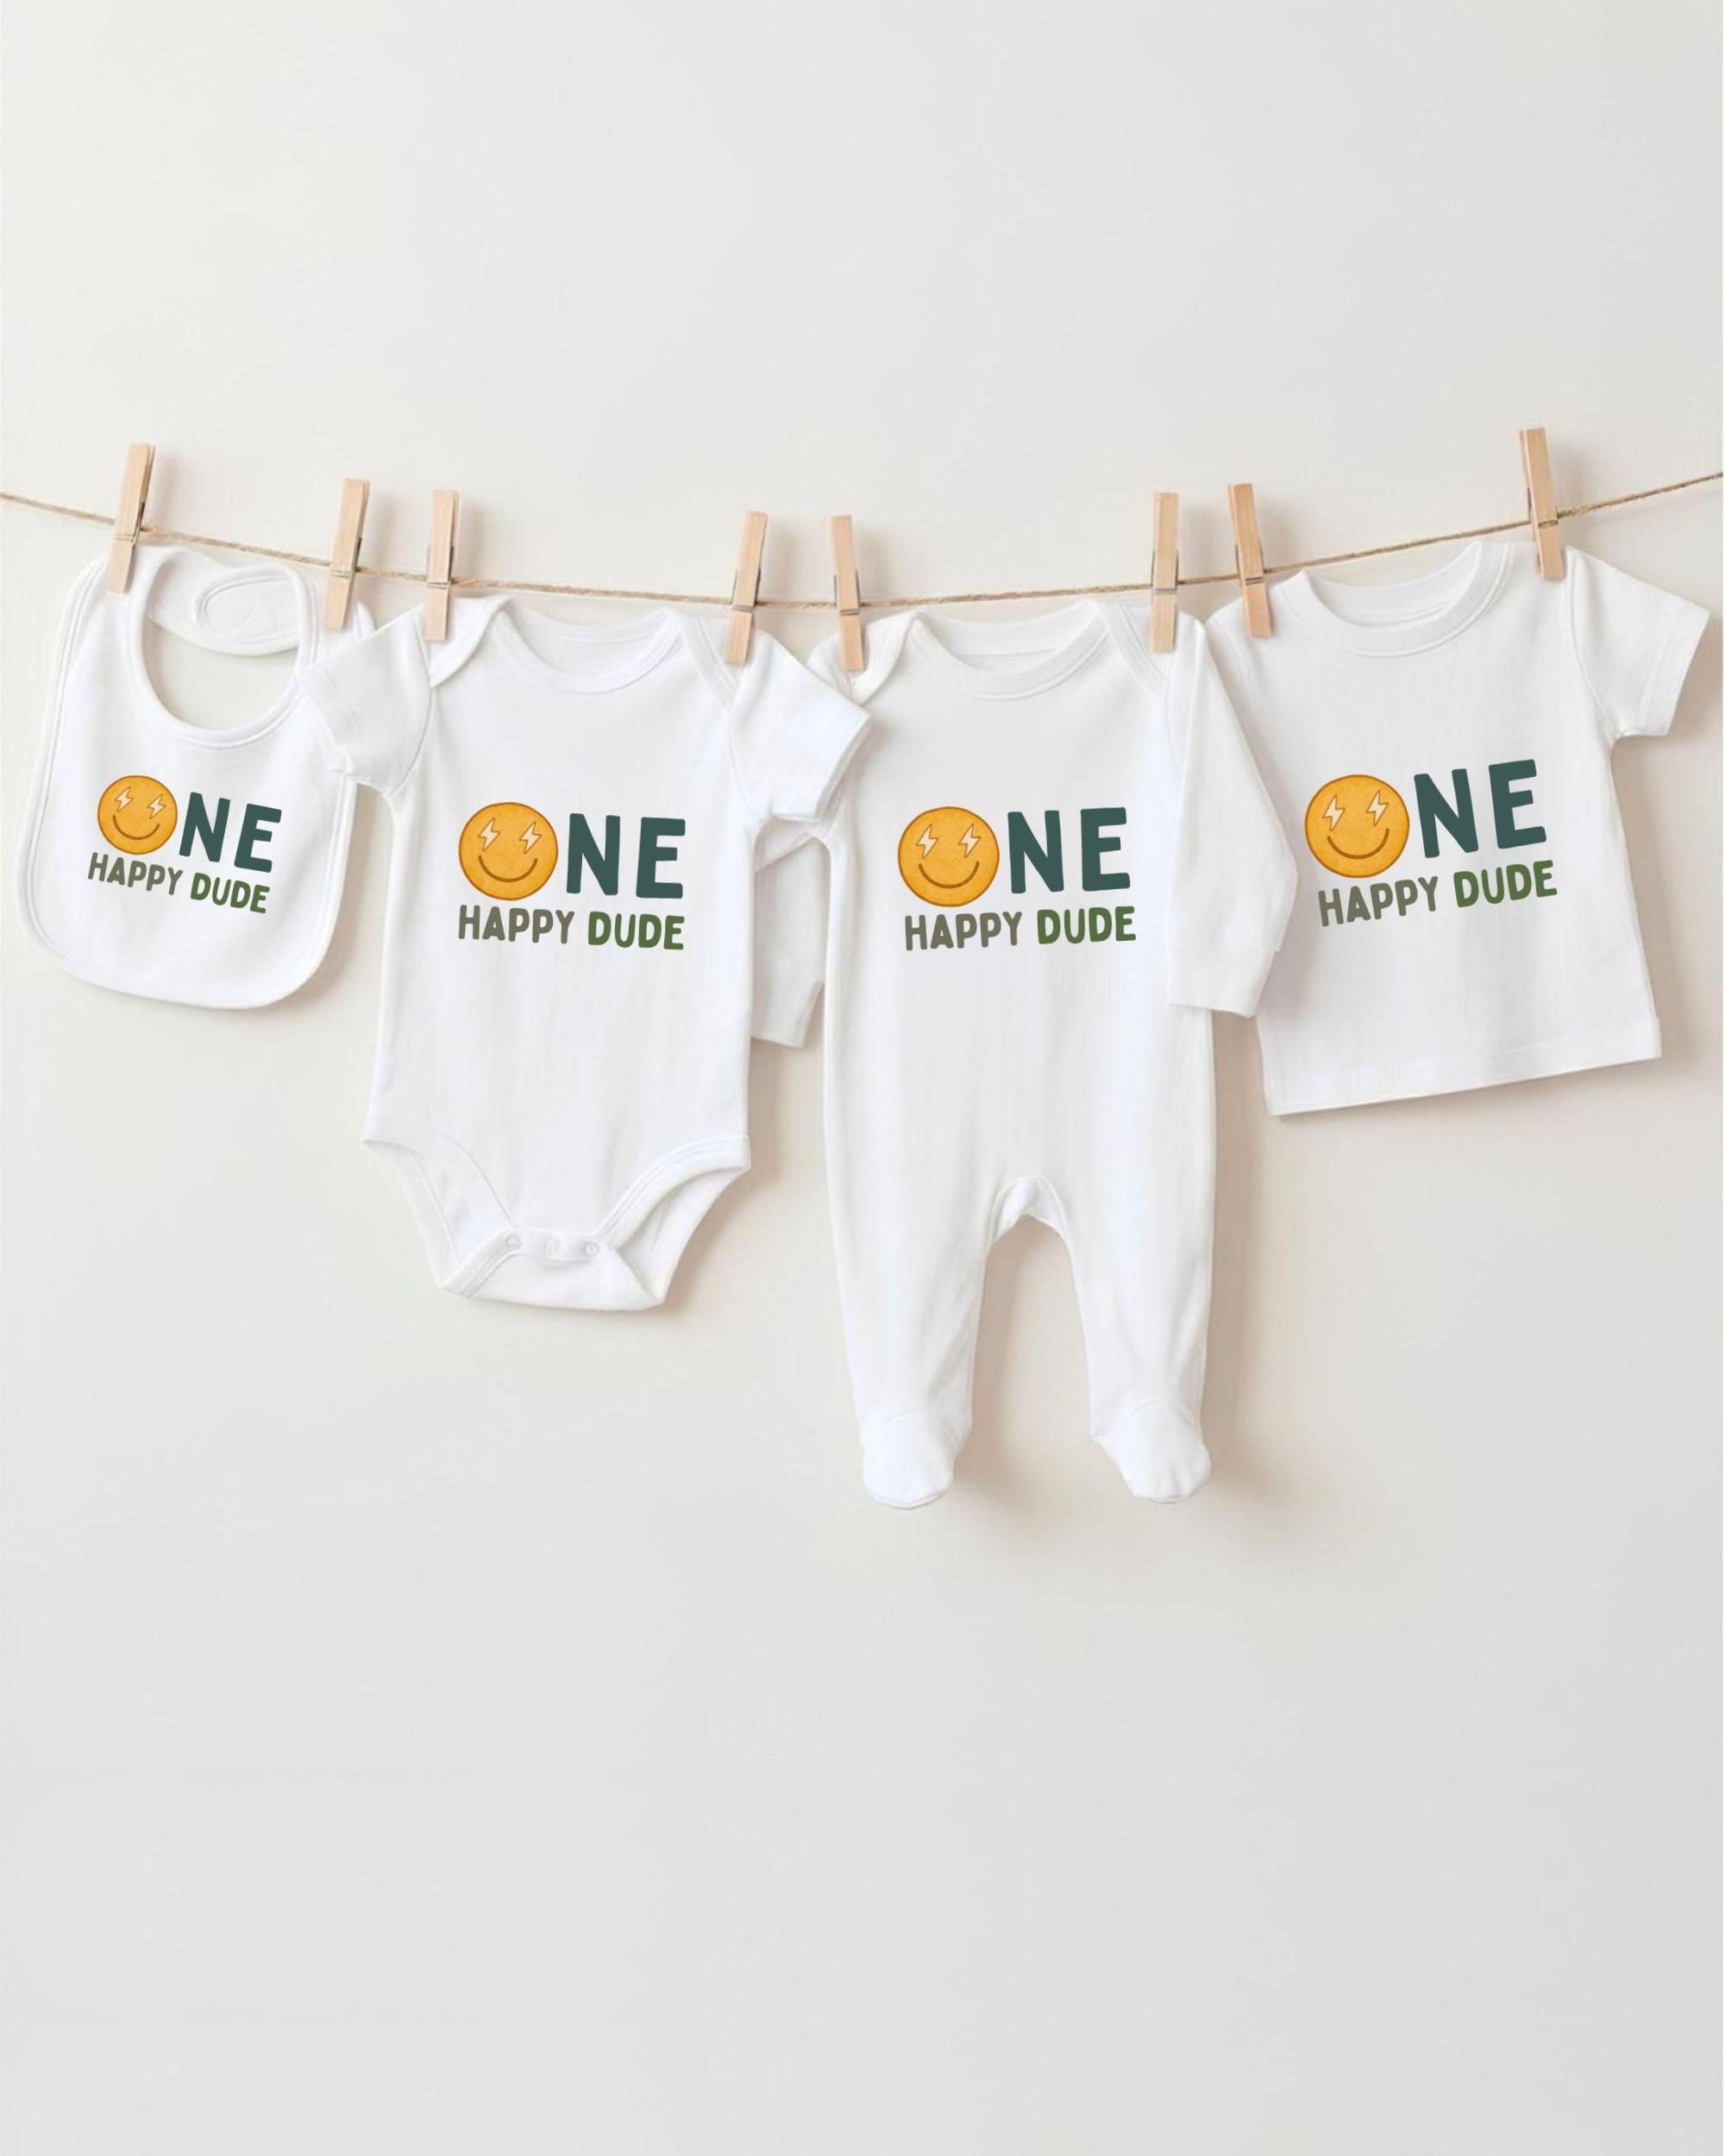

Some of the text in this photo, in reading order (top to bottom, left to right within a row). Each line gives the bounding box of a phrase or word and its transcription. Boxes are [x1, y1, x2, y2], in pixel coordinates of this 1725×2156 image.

[88, 851, 271, 914] HAPPY DUDE
[1318, 859, 1558, 927] HAPPY DUDE
[458, 904, 685, 950] HAPPY DUDE
[904, 906, 1137, 951] HAPPY DUDE
